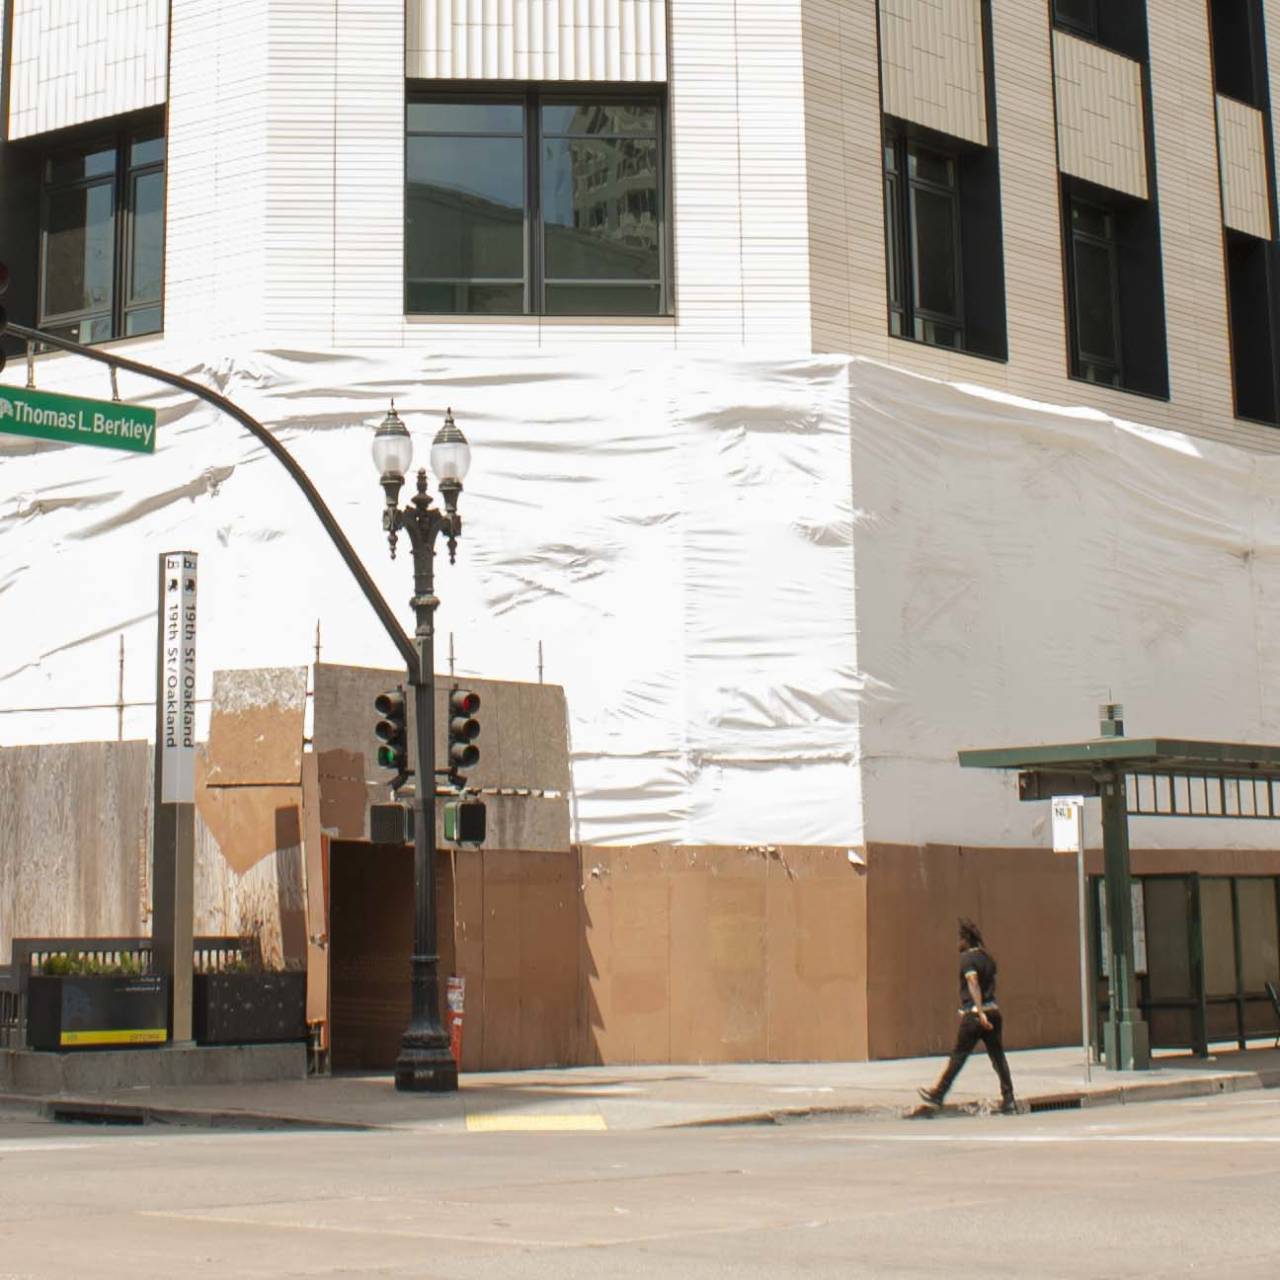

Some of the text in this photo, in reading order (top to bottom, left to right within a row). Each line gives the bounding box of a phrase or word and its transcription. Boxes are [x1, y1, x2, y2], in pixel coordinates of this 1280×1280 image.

[13, 400, 153, 446] Thomas L. Berkley
[167, 604, 179, 640] 19th
[184, 604, 196, 640] 19th
